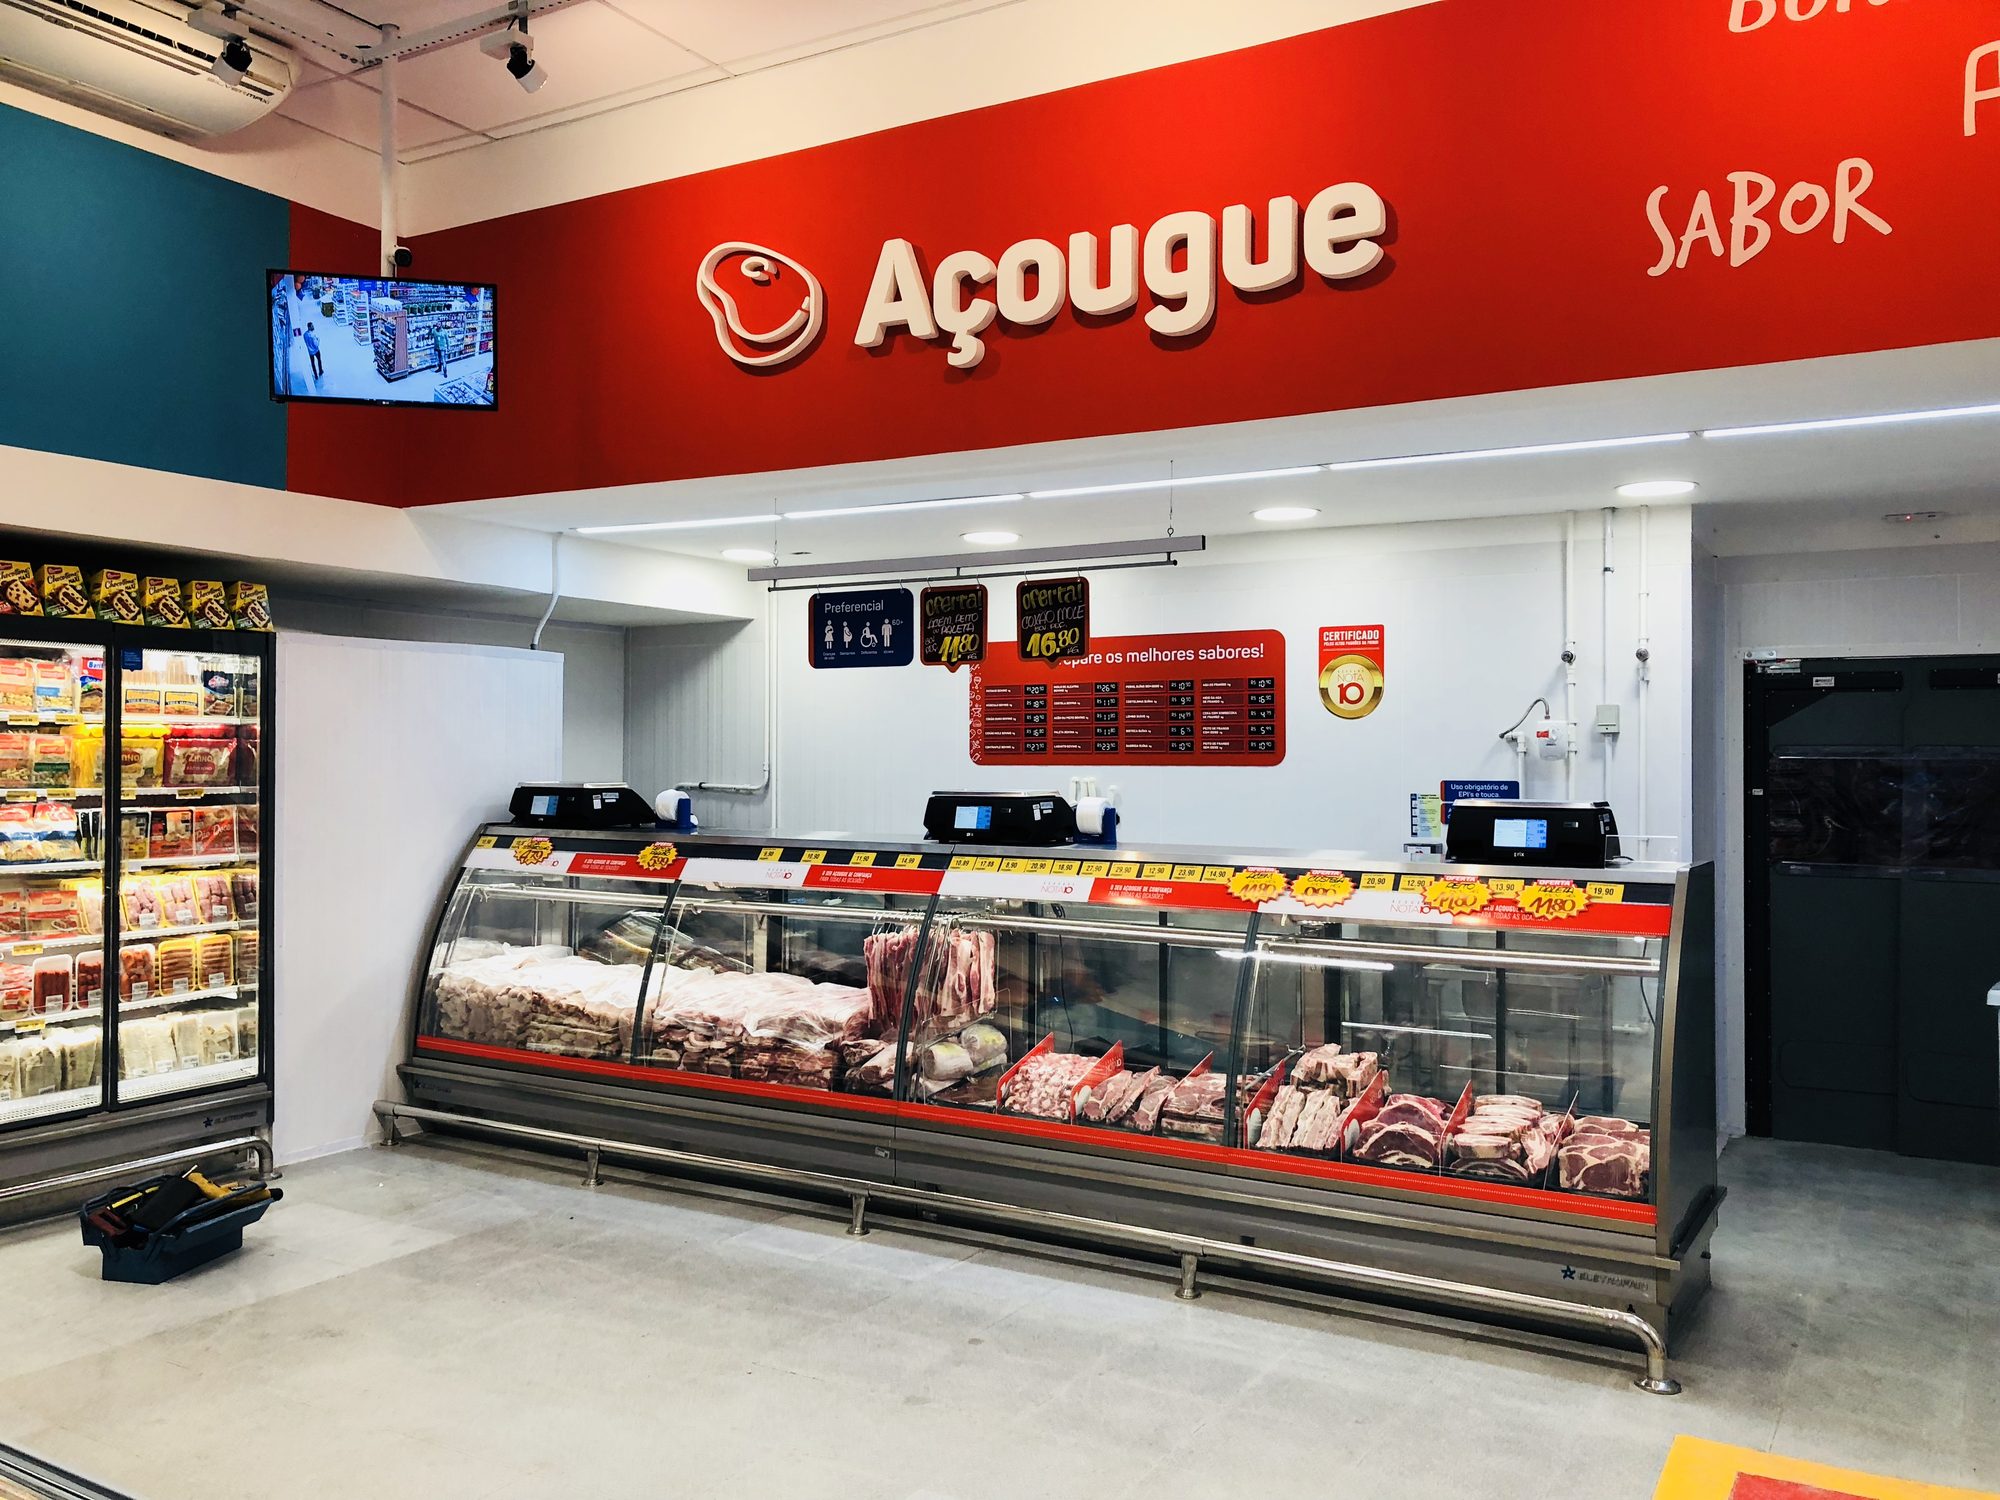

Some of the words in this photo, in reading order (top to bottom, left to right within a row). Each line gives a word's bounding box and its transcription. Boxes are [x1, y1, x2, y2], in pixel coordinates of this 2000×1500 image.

[1646, 157, 1893, 277] SABOR
[854, 181, 1386, 369] Açougue
[824, 599, 884, 613] Preferencial
[891, 618, 904, 626] 60+
[1323, 630, 1379, 641] CERTIFICADO
[1106, 653, 1123, 664] os
[1126, 648, 1195, 663] melhores
[1198, 643, 1264, 660] sabores!
[1337, 682, 1365, 705] 10
[1464, 783, 1499, 791] obrigatório
